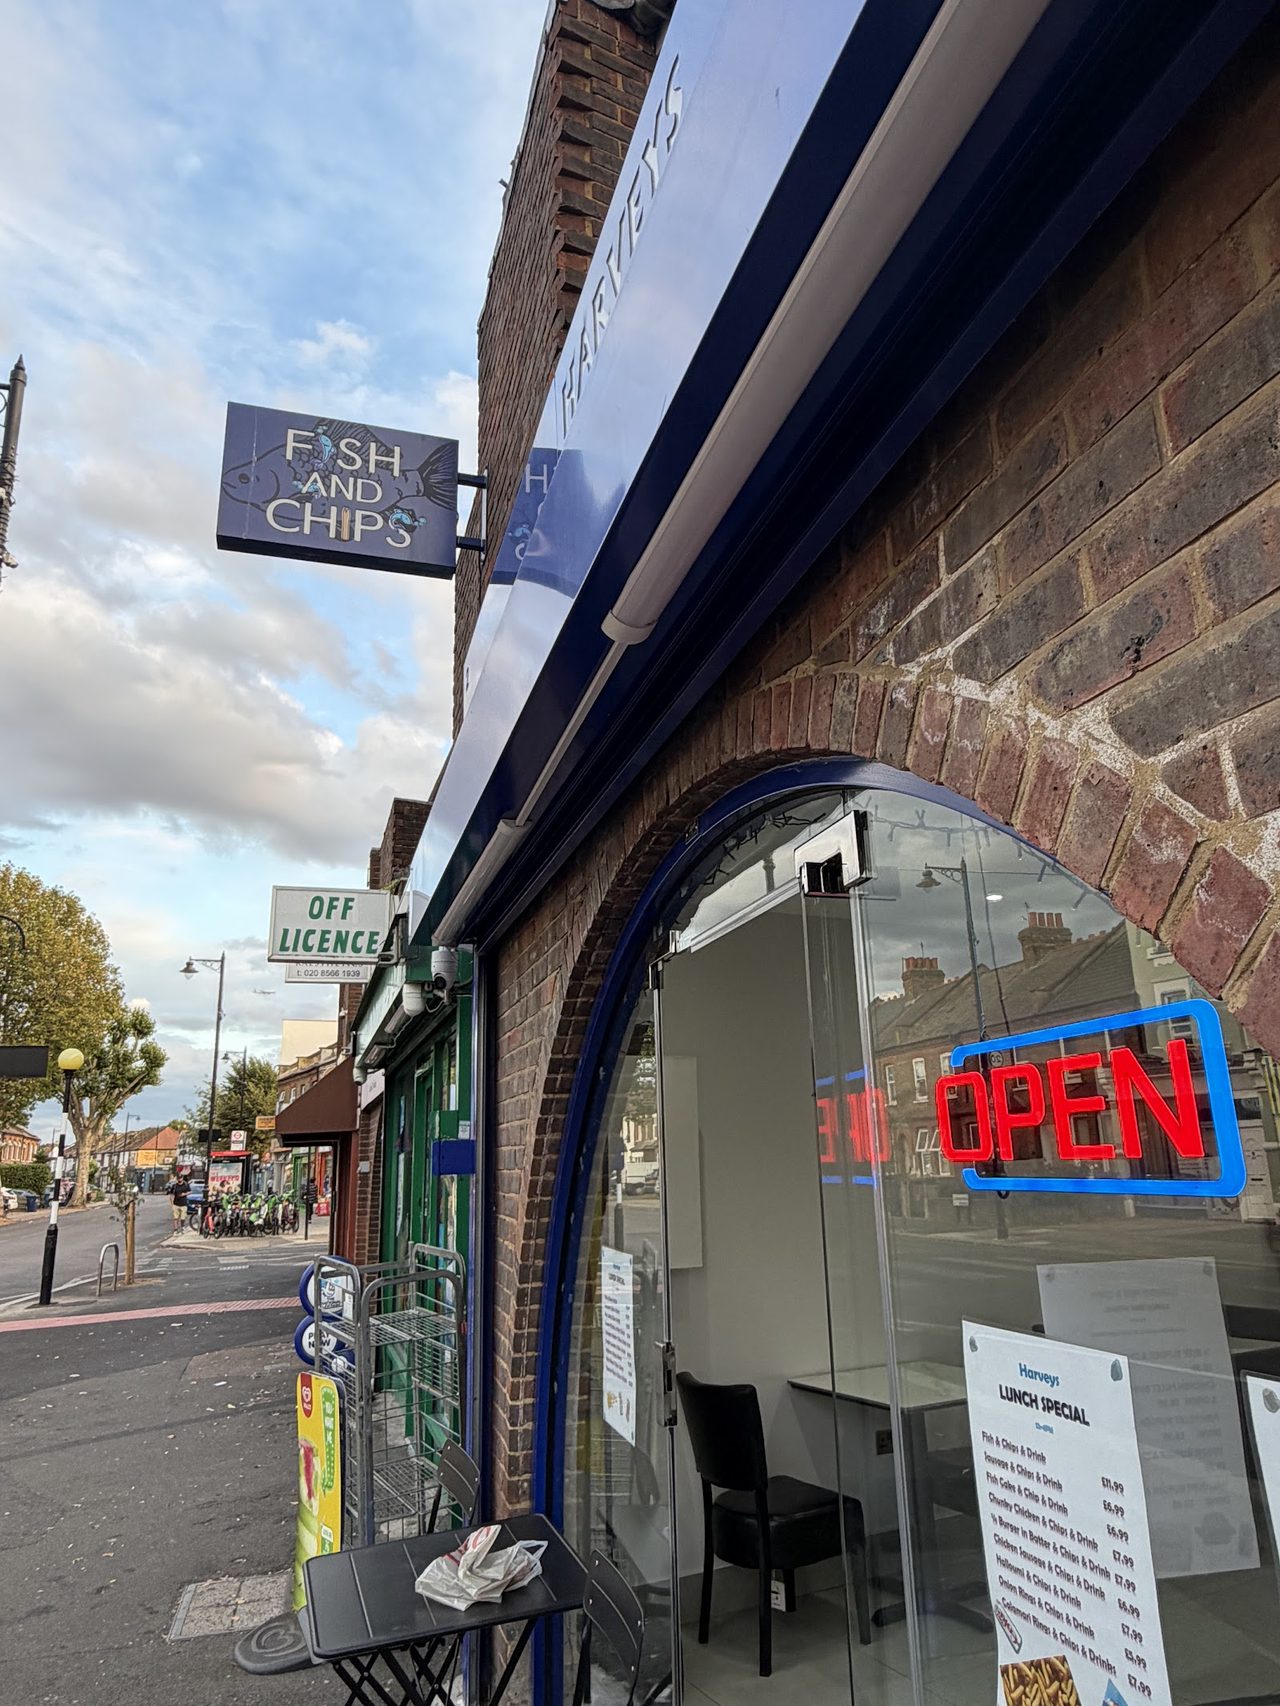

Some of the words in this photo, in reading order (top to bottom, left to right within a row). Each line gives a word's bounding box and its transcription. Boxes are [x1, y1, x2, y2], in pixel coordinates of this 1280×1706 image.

[284, 427, 401, 477] FISH
[301, 471, 383, 504] AND
[265, 498, 412, 548] CHIPS
[308, 895, 355, 920] OFF
[278, 927, 380, 955] LICENCE
[304, 969, 319, 977] 020
[935, 1038, 1205, 1162] OPEN
[308, 1339, 331, 1349] NW
[1018, 1362, 1060, 1387] Harveys
[999, 1384, 1039, 1410] LUNCH
[1041, 1396, 1090, 1426] SPECIAL
[982, 1430, 994, 1444] Fish
[996, 1436, 1000, 1445] &
[1002, 1438, 1018, 1453] Chips
[1020, 1445, 1025, 1456] &
[1027, 1447, 1046, 1463] Drink
[984, 1451, 1008, 1470] Sausage
[1010, 1461, 1015, 1472] &
[1016, 1464, 1034, 1480] Chips
[1036, 1472, 1041, 1482] &
[1042, 1474, 1063, 1491] Drink
[1103, 1500, 1125, 1518] £6.99
[986, 1471, 998, 1484] Fish
[999, 1476, 1016, 1492] Cake
[1018, 1485, 1022, 1495] &
[1042, 1495, 1046, 1506] &
[1048, 1497, 1068, 1515] Drink
[1106, 1524, 1129, 1542] £6.99
[989, 1492, 1012, 1511] Chunky
[1014, 1503, 1040, 1525] Chicken
[1042, 1516, 1047, 1528] &
[1049, 1519, 1068, 1537] Chips
[1070, 1528, 1075, 1540] &
[1077, 1531, 1098, 1551] Drink
[1113, 1549, 1134, 1569] £7.99
[998, 1515, 1019, 1534] Burger
[1021, 1526, 1028, 1538] in
[1029, 1530, 1050, 1549] Batter
[1053, 1542, 1058, 1554] &
[1060, 1545, 1079, 1564] Chips
[1082, 1556, 1087, 1568] &
[1088, 1559, 1111, 1580] Drink
[1115, 1573, 1136, 1593] £7.99
[994, 1533, 1018, 1554] Chicken
[1019, 1546, 1046, 1568] Sausage
[1048, 1560, 1053, 1573] &
[1055, 1564, 1074, 1584] Chips
[1076, 1575, 1081, 1588] &
[1083, 1578, 1105, 1600] Drink
[1118, 1598, 1140, 1619] £6.99
[996, 1553, 1025, 1577] Halloumi
[1026, 1570, 1031, 1582] &
[1033, 1574, 1051, 1594] Chips
[1053, 1585, 1059, 1597] &
[1060, 1587, 1081, 1609] Drink
[1121, 1623, 1143, 1644] £7.99
[998, 1575, 1017, 1594] Onion
[1018, 1586, 1036, 1605] Rings
[1038, 1597, 1043, 1609] &
[1045, 1601, 1063, 1621] Chips
[1066, 1613, 1071, 1626] &
[1072, 1616, 1095, 1638] Drink
[1002, 1597, 1031, 1623] Calamari
[1032, 1615, 1050, 1635] Rings
[1052, 1628, 1058, 1640] &
[1060, 1632, 1079, 1654] Chips
[1081, 1645, 1087, 1658] &
[1089, 1648, 1116, 1676] Drinks
[1128, 1673, 1152, 1700] £7.99
